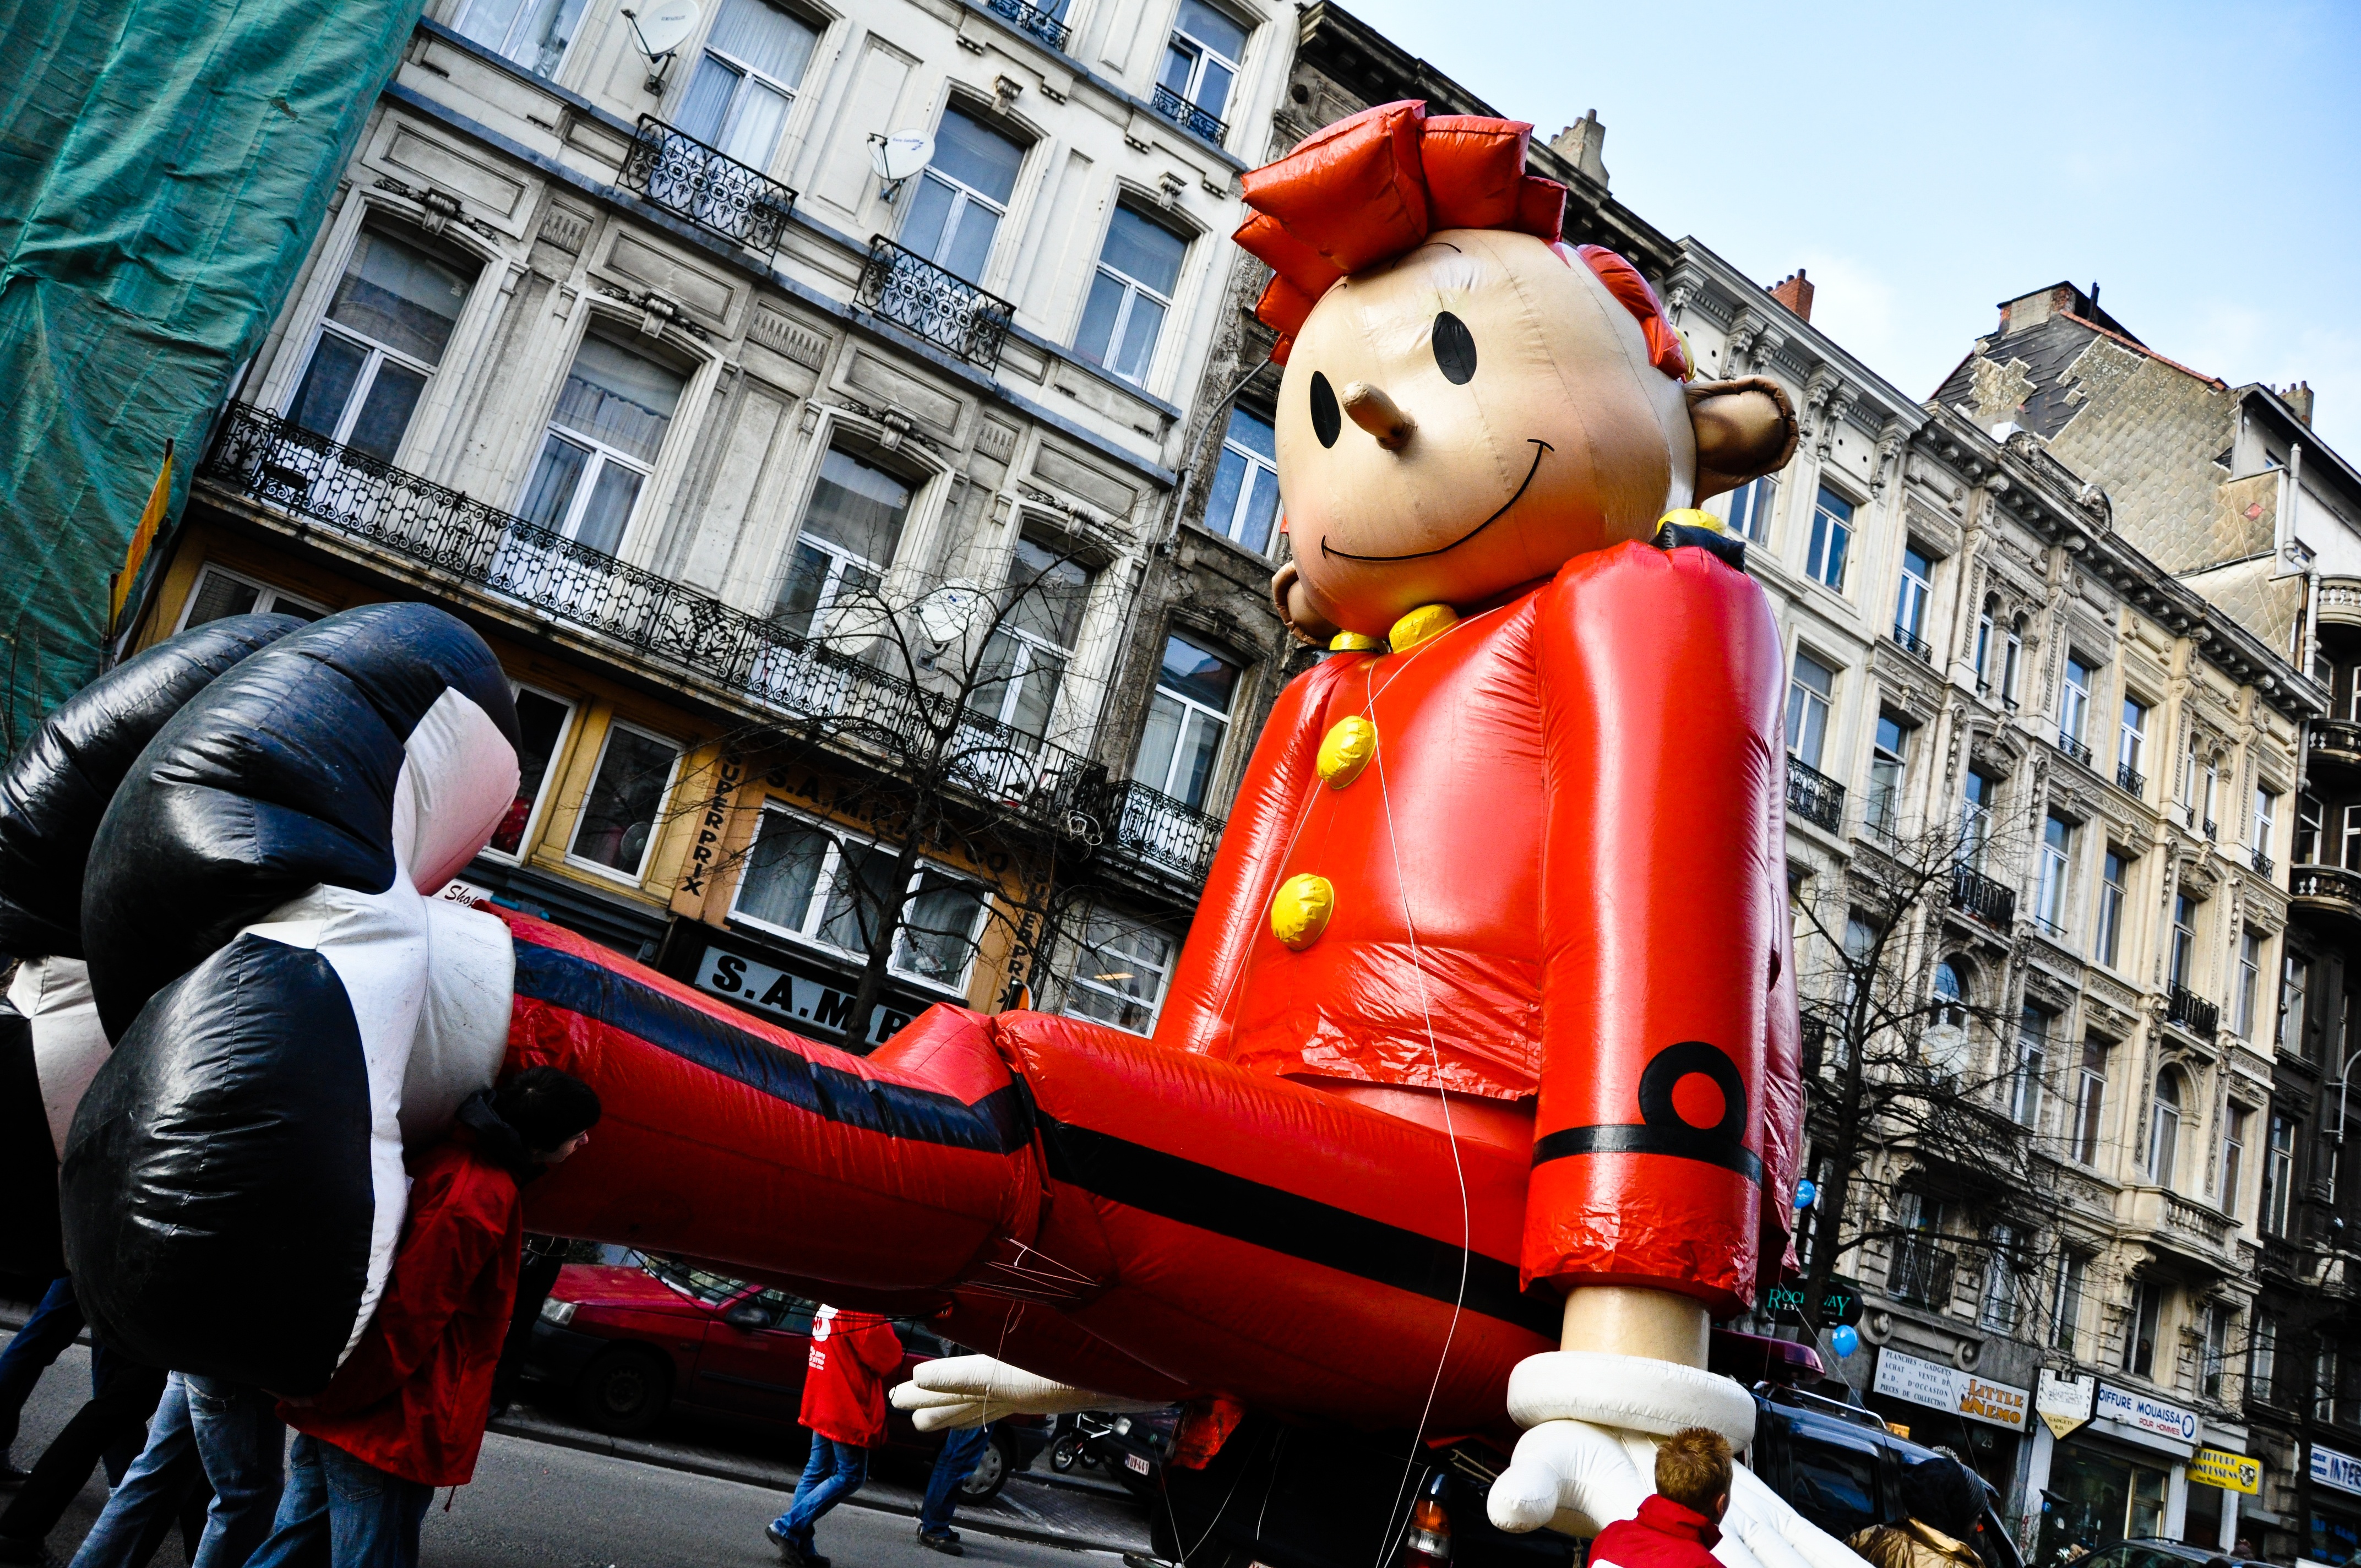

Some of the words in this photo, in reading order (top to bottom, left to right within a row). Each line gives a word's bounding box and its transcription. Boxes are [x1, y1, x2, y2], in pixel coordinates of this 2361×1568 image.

[682, 748, 742, 897] SUPERPRIX
[1884, 1362, 1905, 1373] ACHAT
[1918, 1371, 1936, 1382] VENTE
[1942, 1379, 1950, 1387] DE
[1886, 1351, 1917, 1366] PLANCHES
[1924, 1363, 1952, 1376] GADGETS
[1882, 1372, 1898, 1383] B.D.
[1908, 1380, 1948, 1397] D'OCCASION
[1967, 1379, 2023, 1408] LITTLE
[1902, 1390, 1911, 1398] DE
[1914, 1393, 1946, 1407] COLLECTION
[1970, 1397, 2021, 1424] NEMO
[2098, 1389, 2132, 1410] OIFFURE
[2136, 1401, 2181, 1425] MOUAISSA
[2048, 1417, 2073, 1425] GADGETS
[2139, 1418, 2154, 1428] POUR
[2156, 1422, 2180, 1436] HOMMES
[1981, 1435, 1993, 1449] 25
